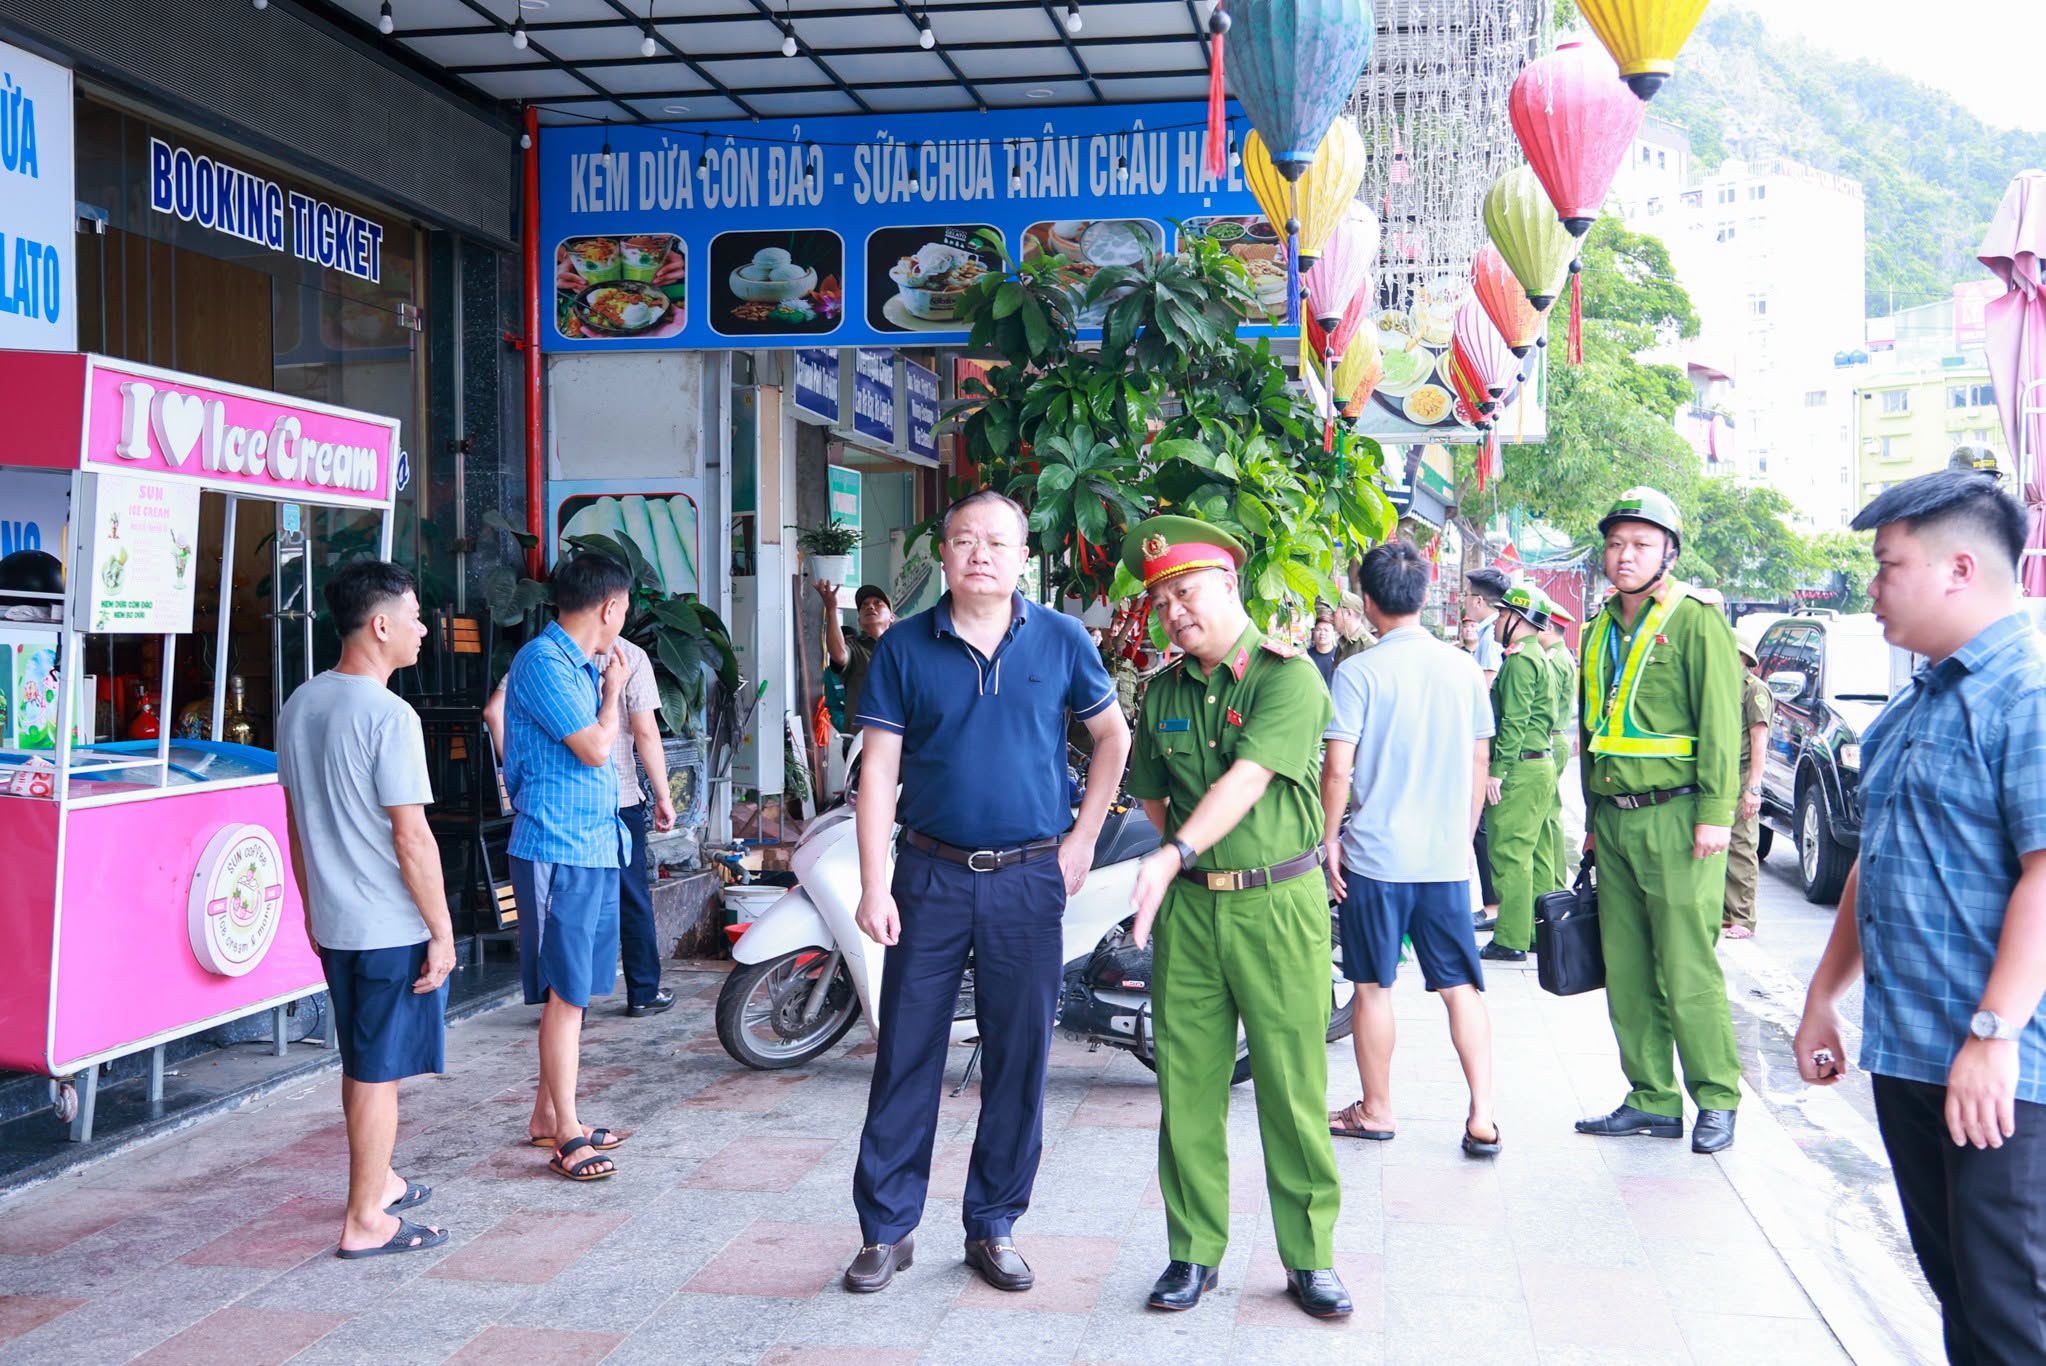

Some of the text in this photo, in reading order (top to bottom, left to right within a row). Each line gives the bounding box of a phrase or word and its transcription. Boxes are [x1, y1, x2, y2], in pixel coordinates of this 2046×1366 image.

[571, 152, 629, 212] KEM
[639, 137, 693, 210] DỪA
[703, 134, 759, 209] CÔN
[768, 124, 824, 206] ĐẢO
[834, 173, 843, 185] -
[854, 129, 910, 205] SỮA
[919, 138, 994, 202] CHUA
[1003, 122, 1079, 199] TRÂN
[1089, 119, 1167, 197] CHÂU
[1178, 130, 1218, 208] HẠ
[150, 137, 383, 284] BOOKING TICKET
[116, 382, 155, 459] I
[202, 399, 267, 475] Ice
[267, 416, 378, 491] Cream
[128, 505, 170, 519] ICE CREAM
[139, 485, 164, 501] SUN
[227, 843, 268, 875] SUN coffee
[218, 914, 227, 937] Ice
[225, 936, 249, 954] cream
[257, 903, 273, 937] more
